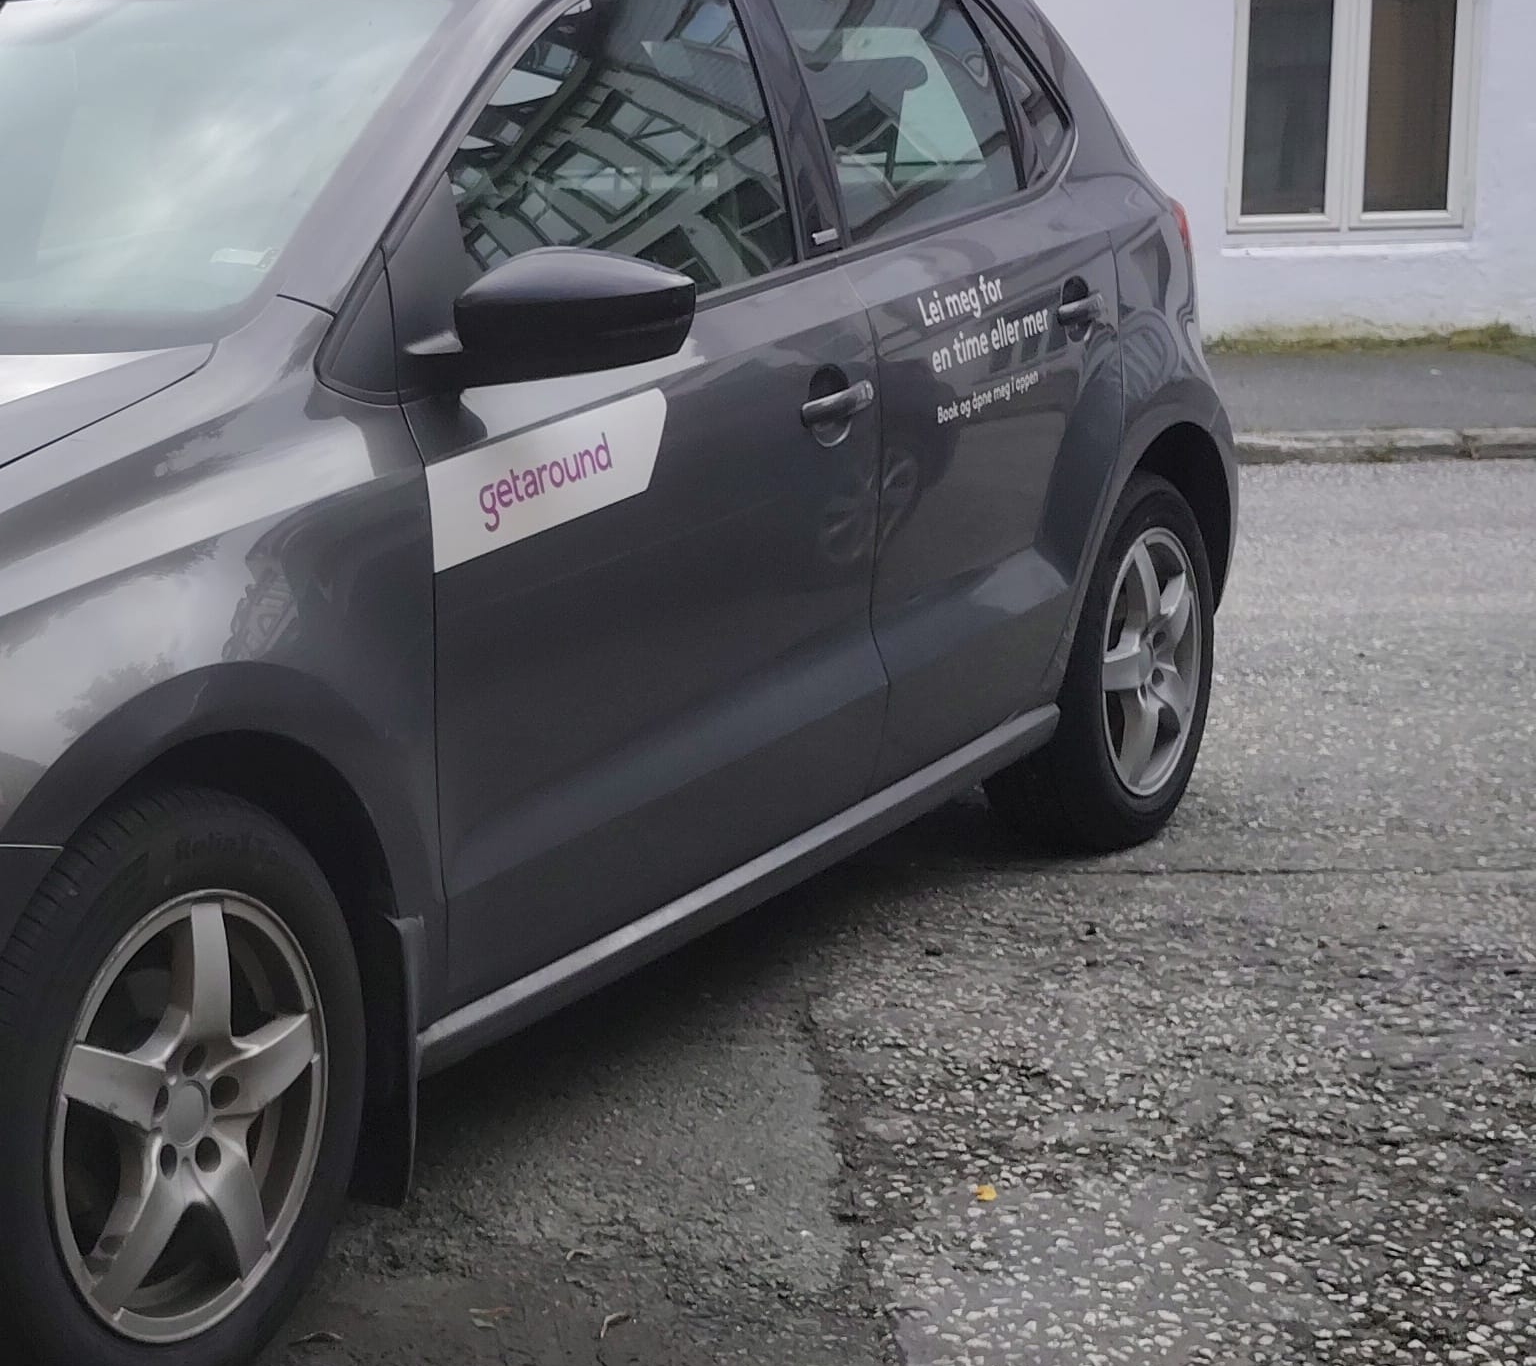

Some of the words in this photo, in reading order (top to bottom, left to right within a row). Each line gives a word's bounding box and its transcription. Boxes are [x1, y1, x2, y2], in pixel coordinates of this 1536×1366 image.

[916, 290, 946, 327] Lei
[944, 286, 982, 319] meg
[978, 274, 1003, 305] for
[931, 346, 953, 373] en
[952, 330, 990, 365] time
[990, 316, 1020, 351] eller
[1022, 308, 1049, 339] mer
[937, 400, 960, 425] Book
[959, 399, 972, 419] og
[993, 382, 1011, 402] meg
[1010, 375, 1015, 394] i
[478, 432, 613, 533] getaround
